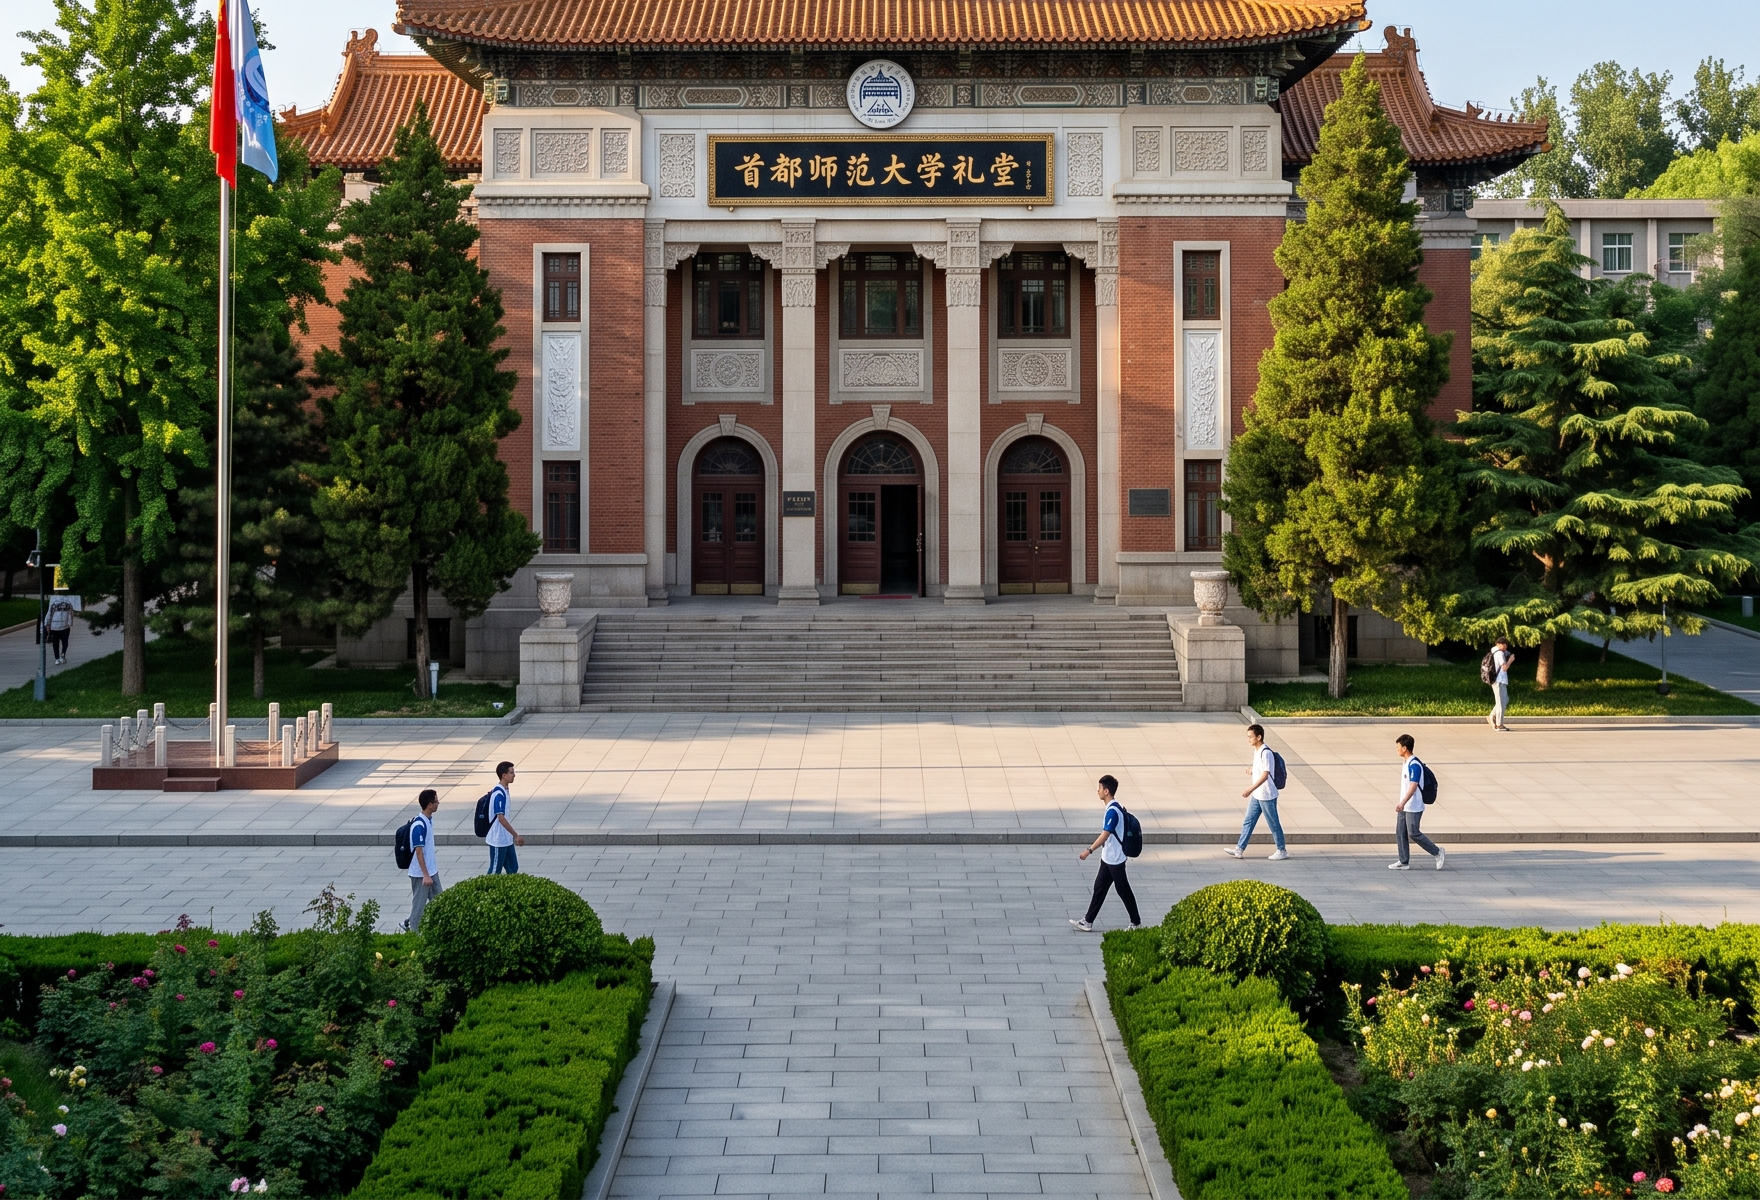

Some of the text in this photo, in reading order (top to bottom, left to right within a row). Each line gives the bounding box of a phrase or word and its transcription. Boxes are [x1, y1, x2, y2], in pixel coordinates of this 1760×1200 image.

[734, 152, 1020, 189] 首都师范大学礼堂
